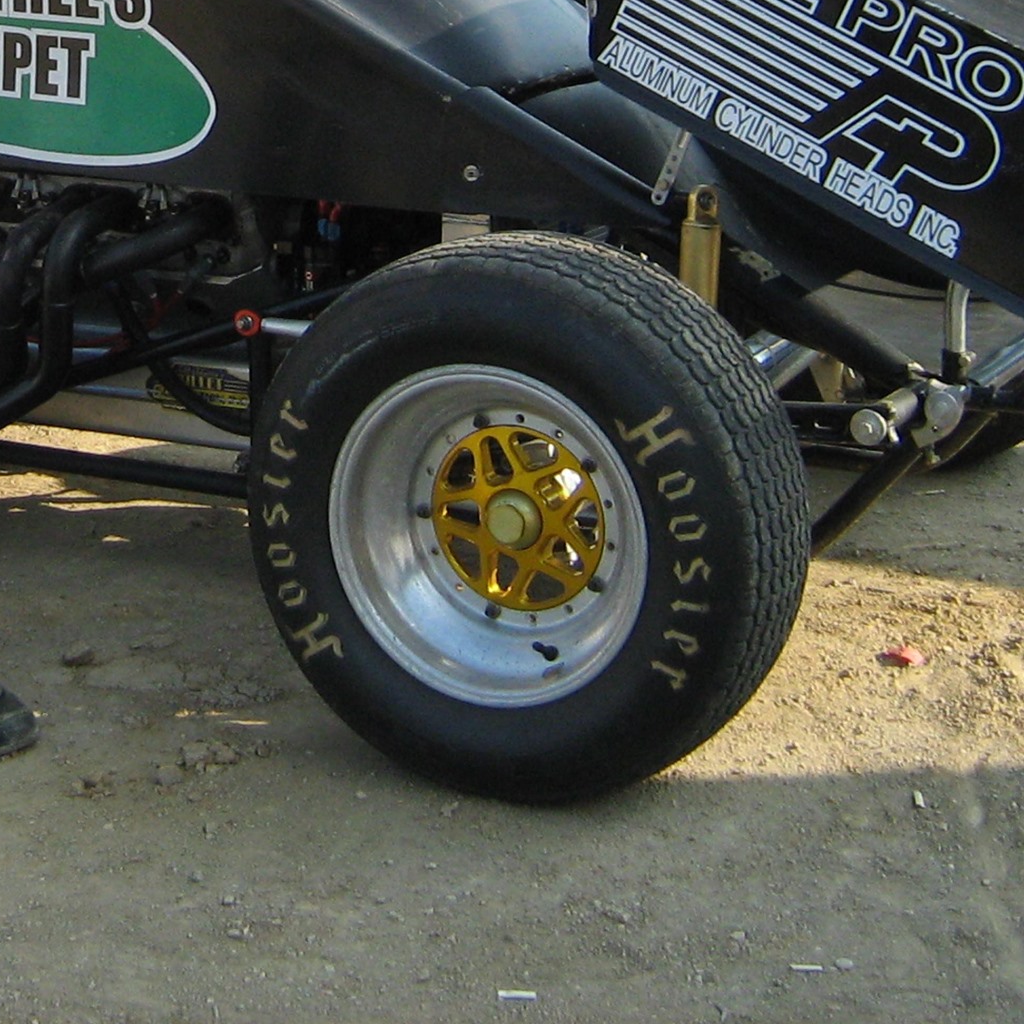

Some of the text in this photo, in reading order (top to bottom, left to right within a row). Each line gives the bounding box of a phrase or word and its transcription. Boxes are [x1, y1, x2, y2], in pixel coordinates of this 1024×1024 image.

[597, 34, 719, 120] ALUMINUM
[714, 97, 828, 184] CYLINDER
[824, 156, 913, 228] HEADS
[261, 399, 345, 665] Hoosier
[616, 405, 712, 690] Hoosier
